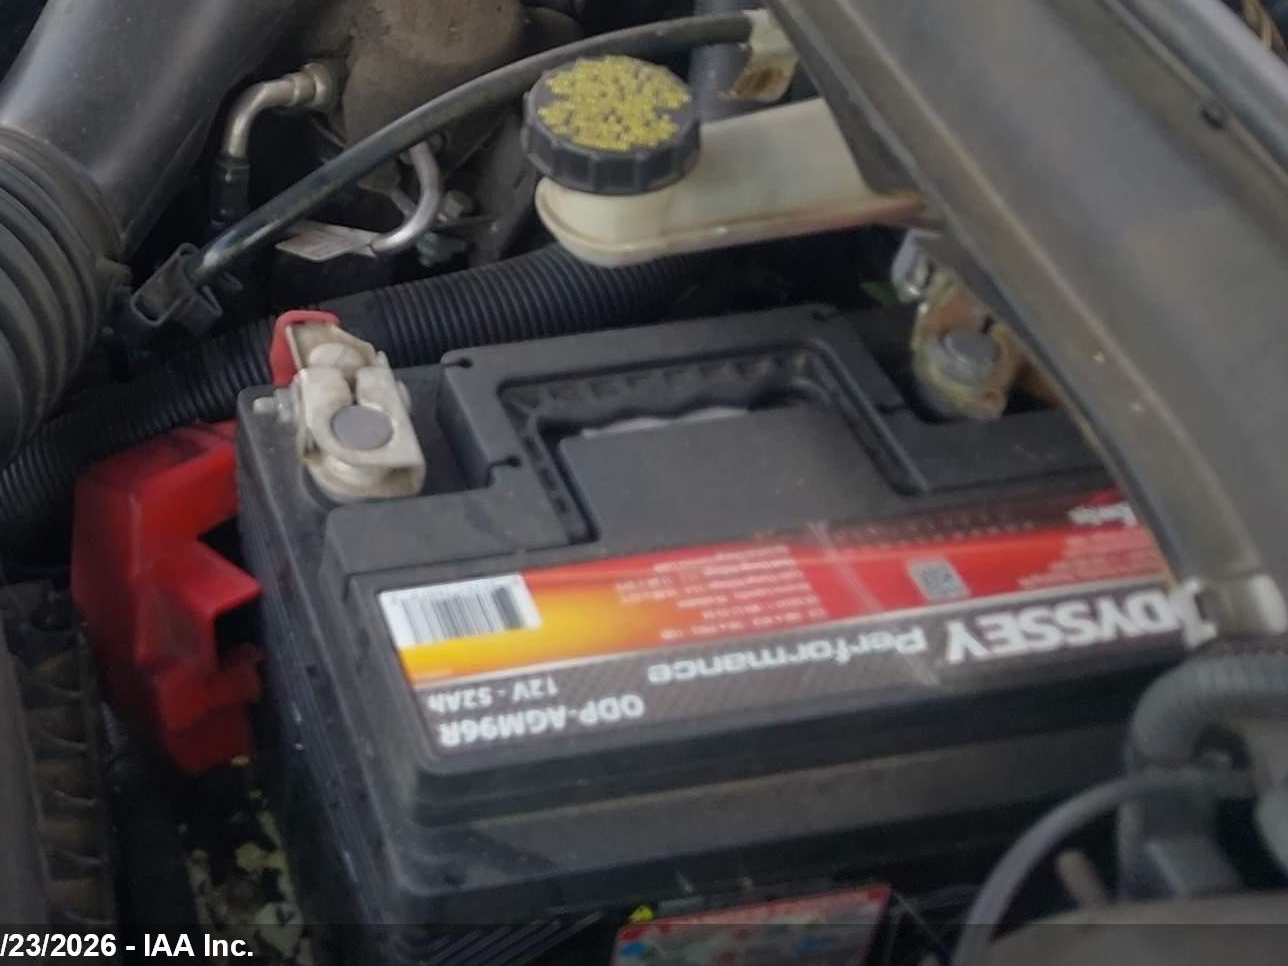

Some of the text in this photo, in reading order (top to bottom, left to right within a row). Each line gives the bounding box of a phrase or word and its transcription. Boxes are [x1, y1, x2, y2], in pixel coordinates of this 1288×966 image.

[646, 590, 1179, 685] DYSSEY Performance
[427, 686, 494, 714] 52Ah
[513, 676, 559, 702] 12V
[439, 693, 645, 748] ODP-AGM96R
